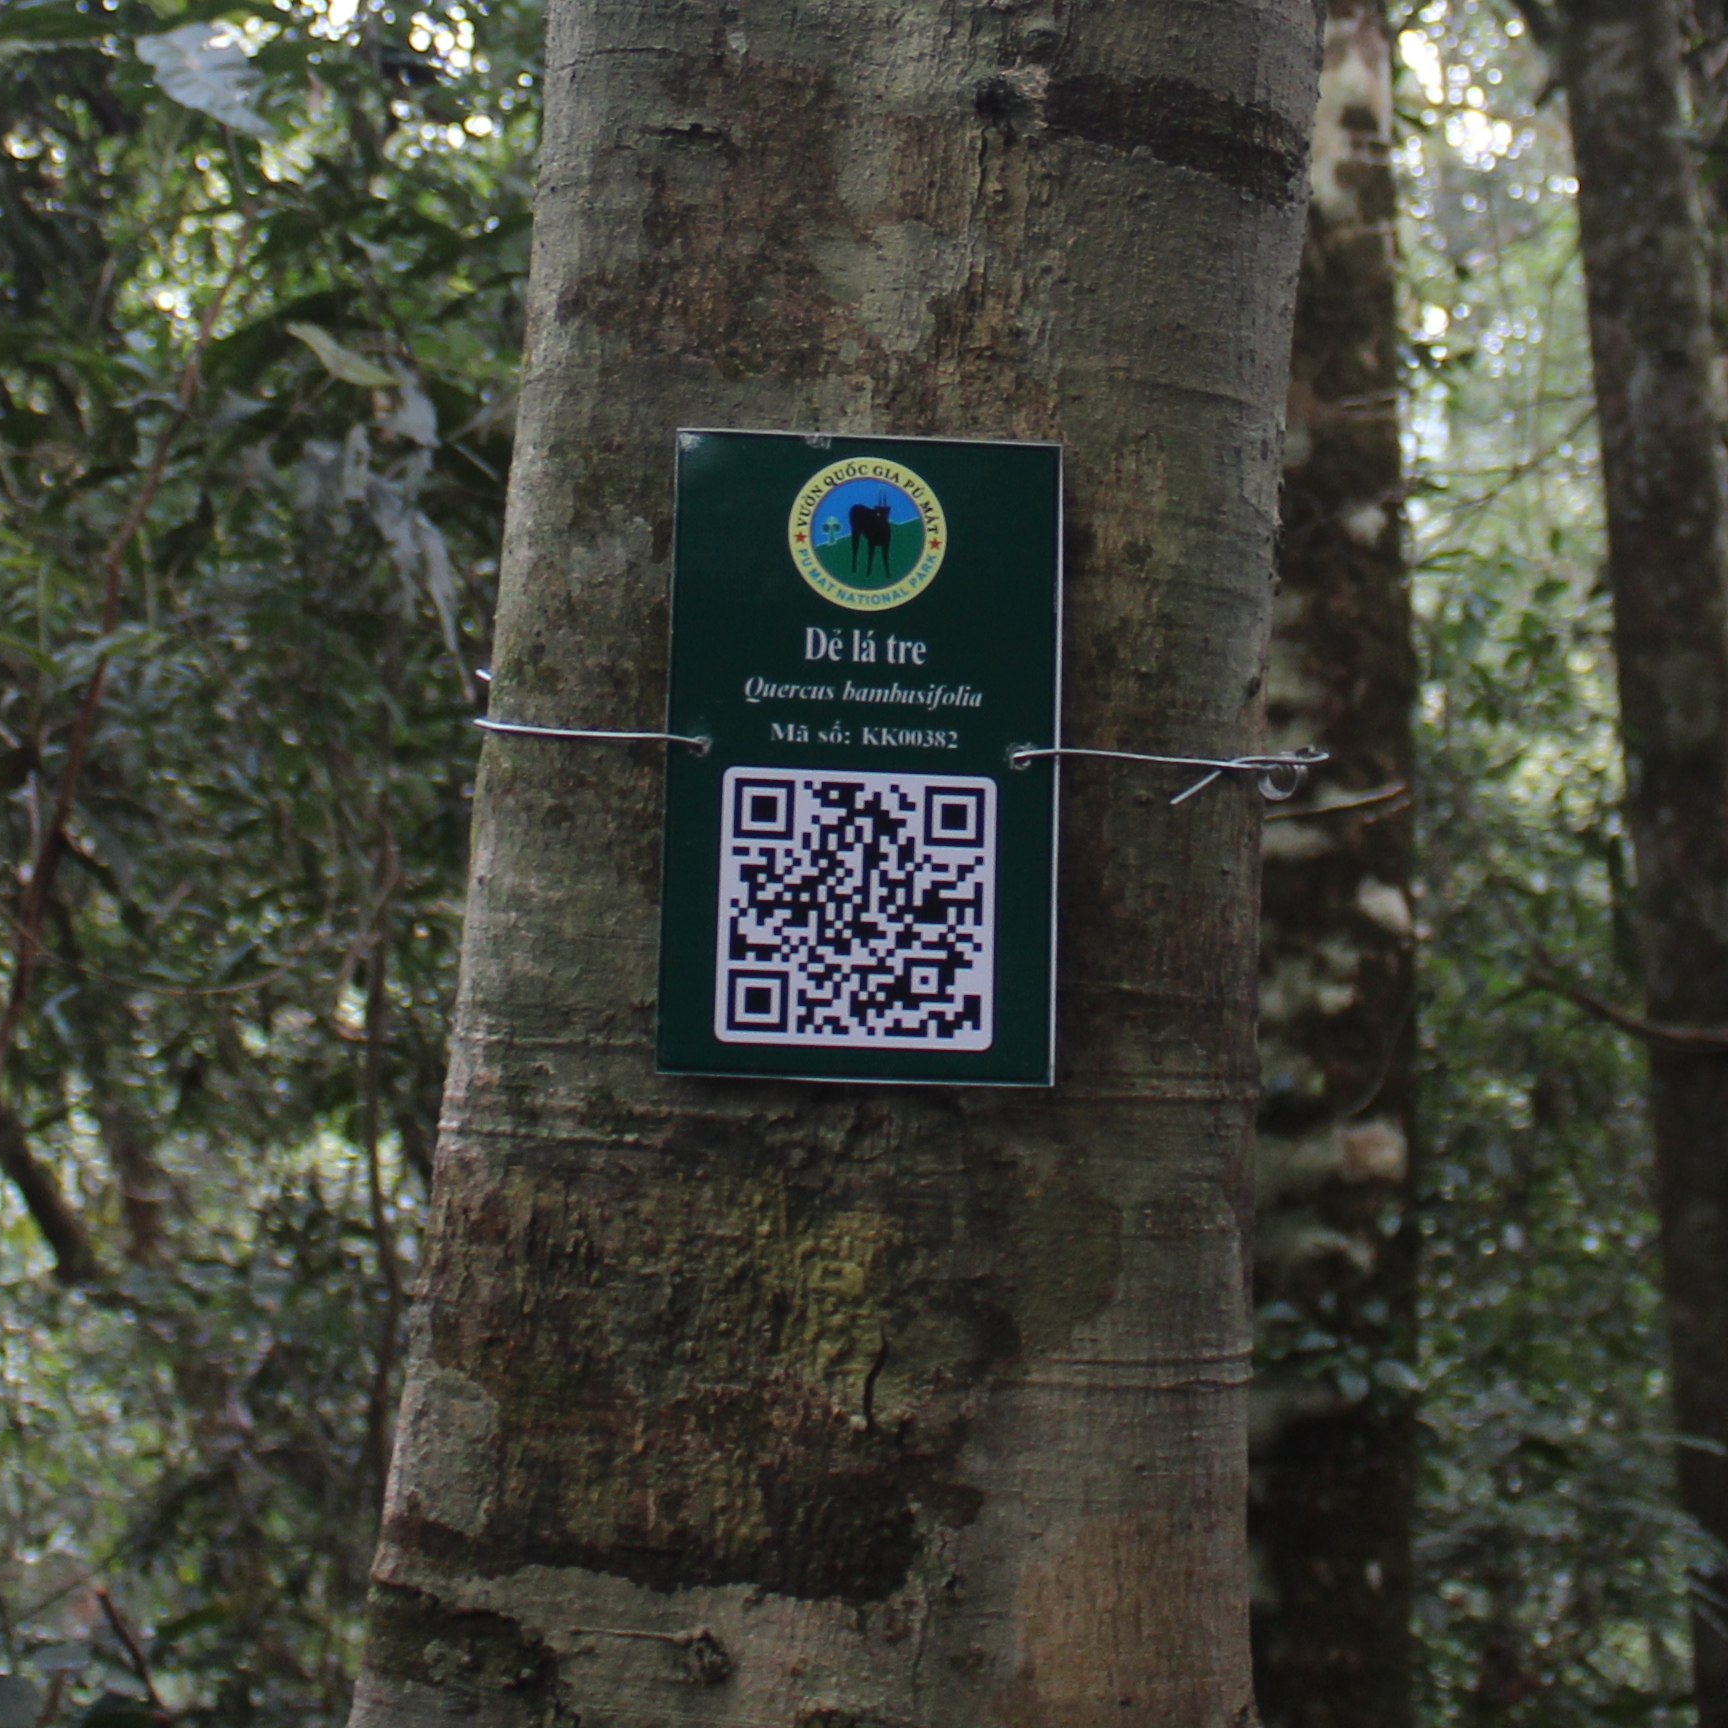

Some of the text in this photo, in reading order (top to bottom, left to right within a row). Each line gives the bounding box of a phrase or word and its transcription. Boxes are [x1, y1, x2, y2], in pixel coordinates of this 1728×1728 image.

[797, 485, 824, 528] VƯỜN
[823, 461, 869, 487] QUỐC
[872, 465, 901, 484] GIA
[798, 548, 938, 606] PU MAT NATIONAL PARK
[804, 626, 928, 666] Dẻ lá tre
[744, 675, 983, 712] Quercus bambusifolia
[770, 719, 959, 750] Mã số: KK00382
